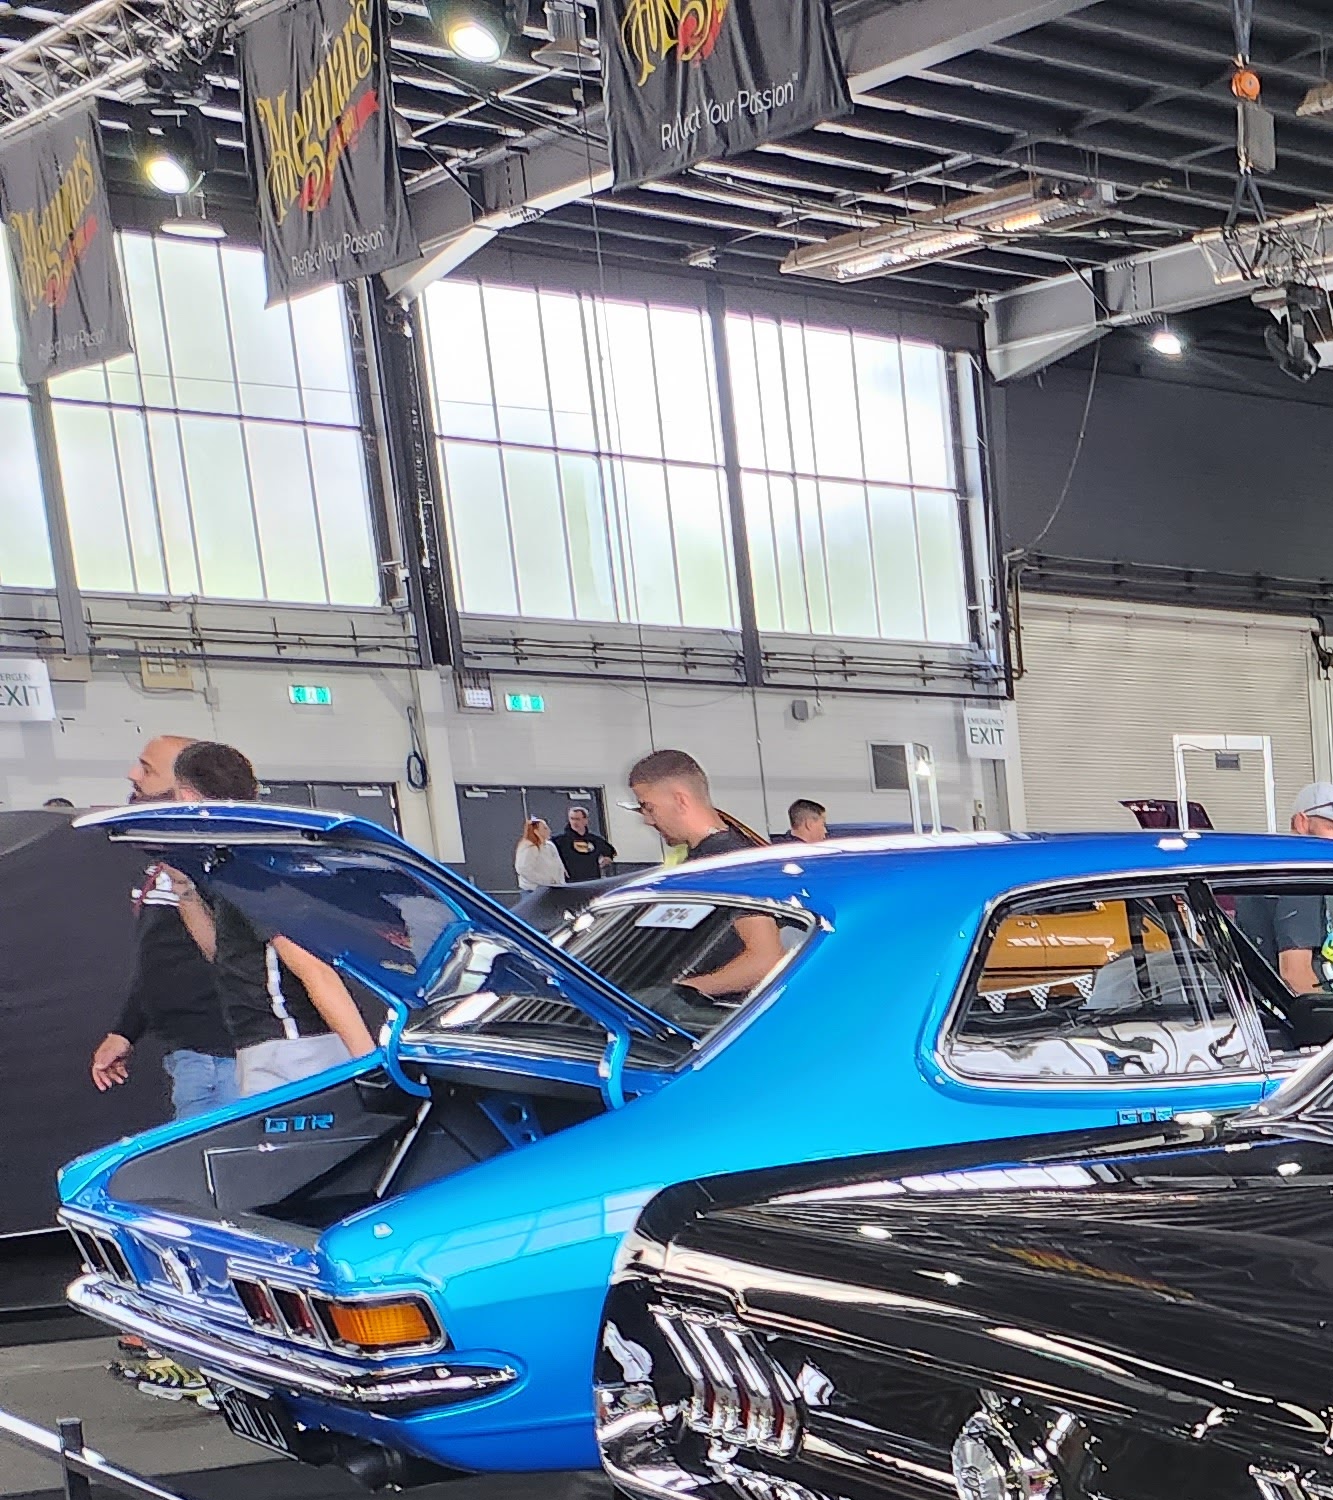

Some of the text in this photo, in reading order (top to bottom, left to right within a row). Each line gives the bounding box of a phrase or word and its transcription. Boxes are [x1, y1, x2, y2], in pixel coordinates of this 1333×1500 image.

[703, 98, 736, 125] Your
[970, 727, 1004, 744] EXIT
[264, 1113, 334, 1133] GTR
